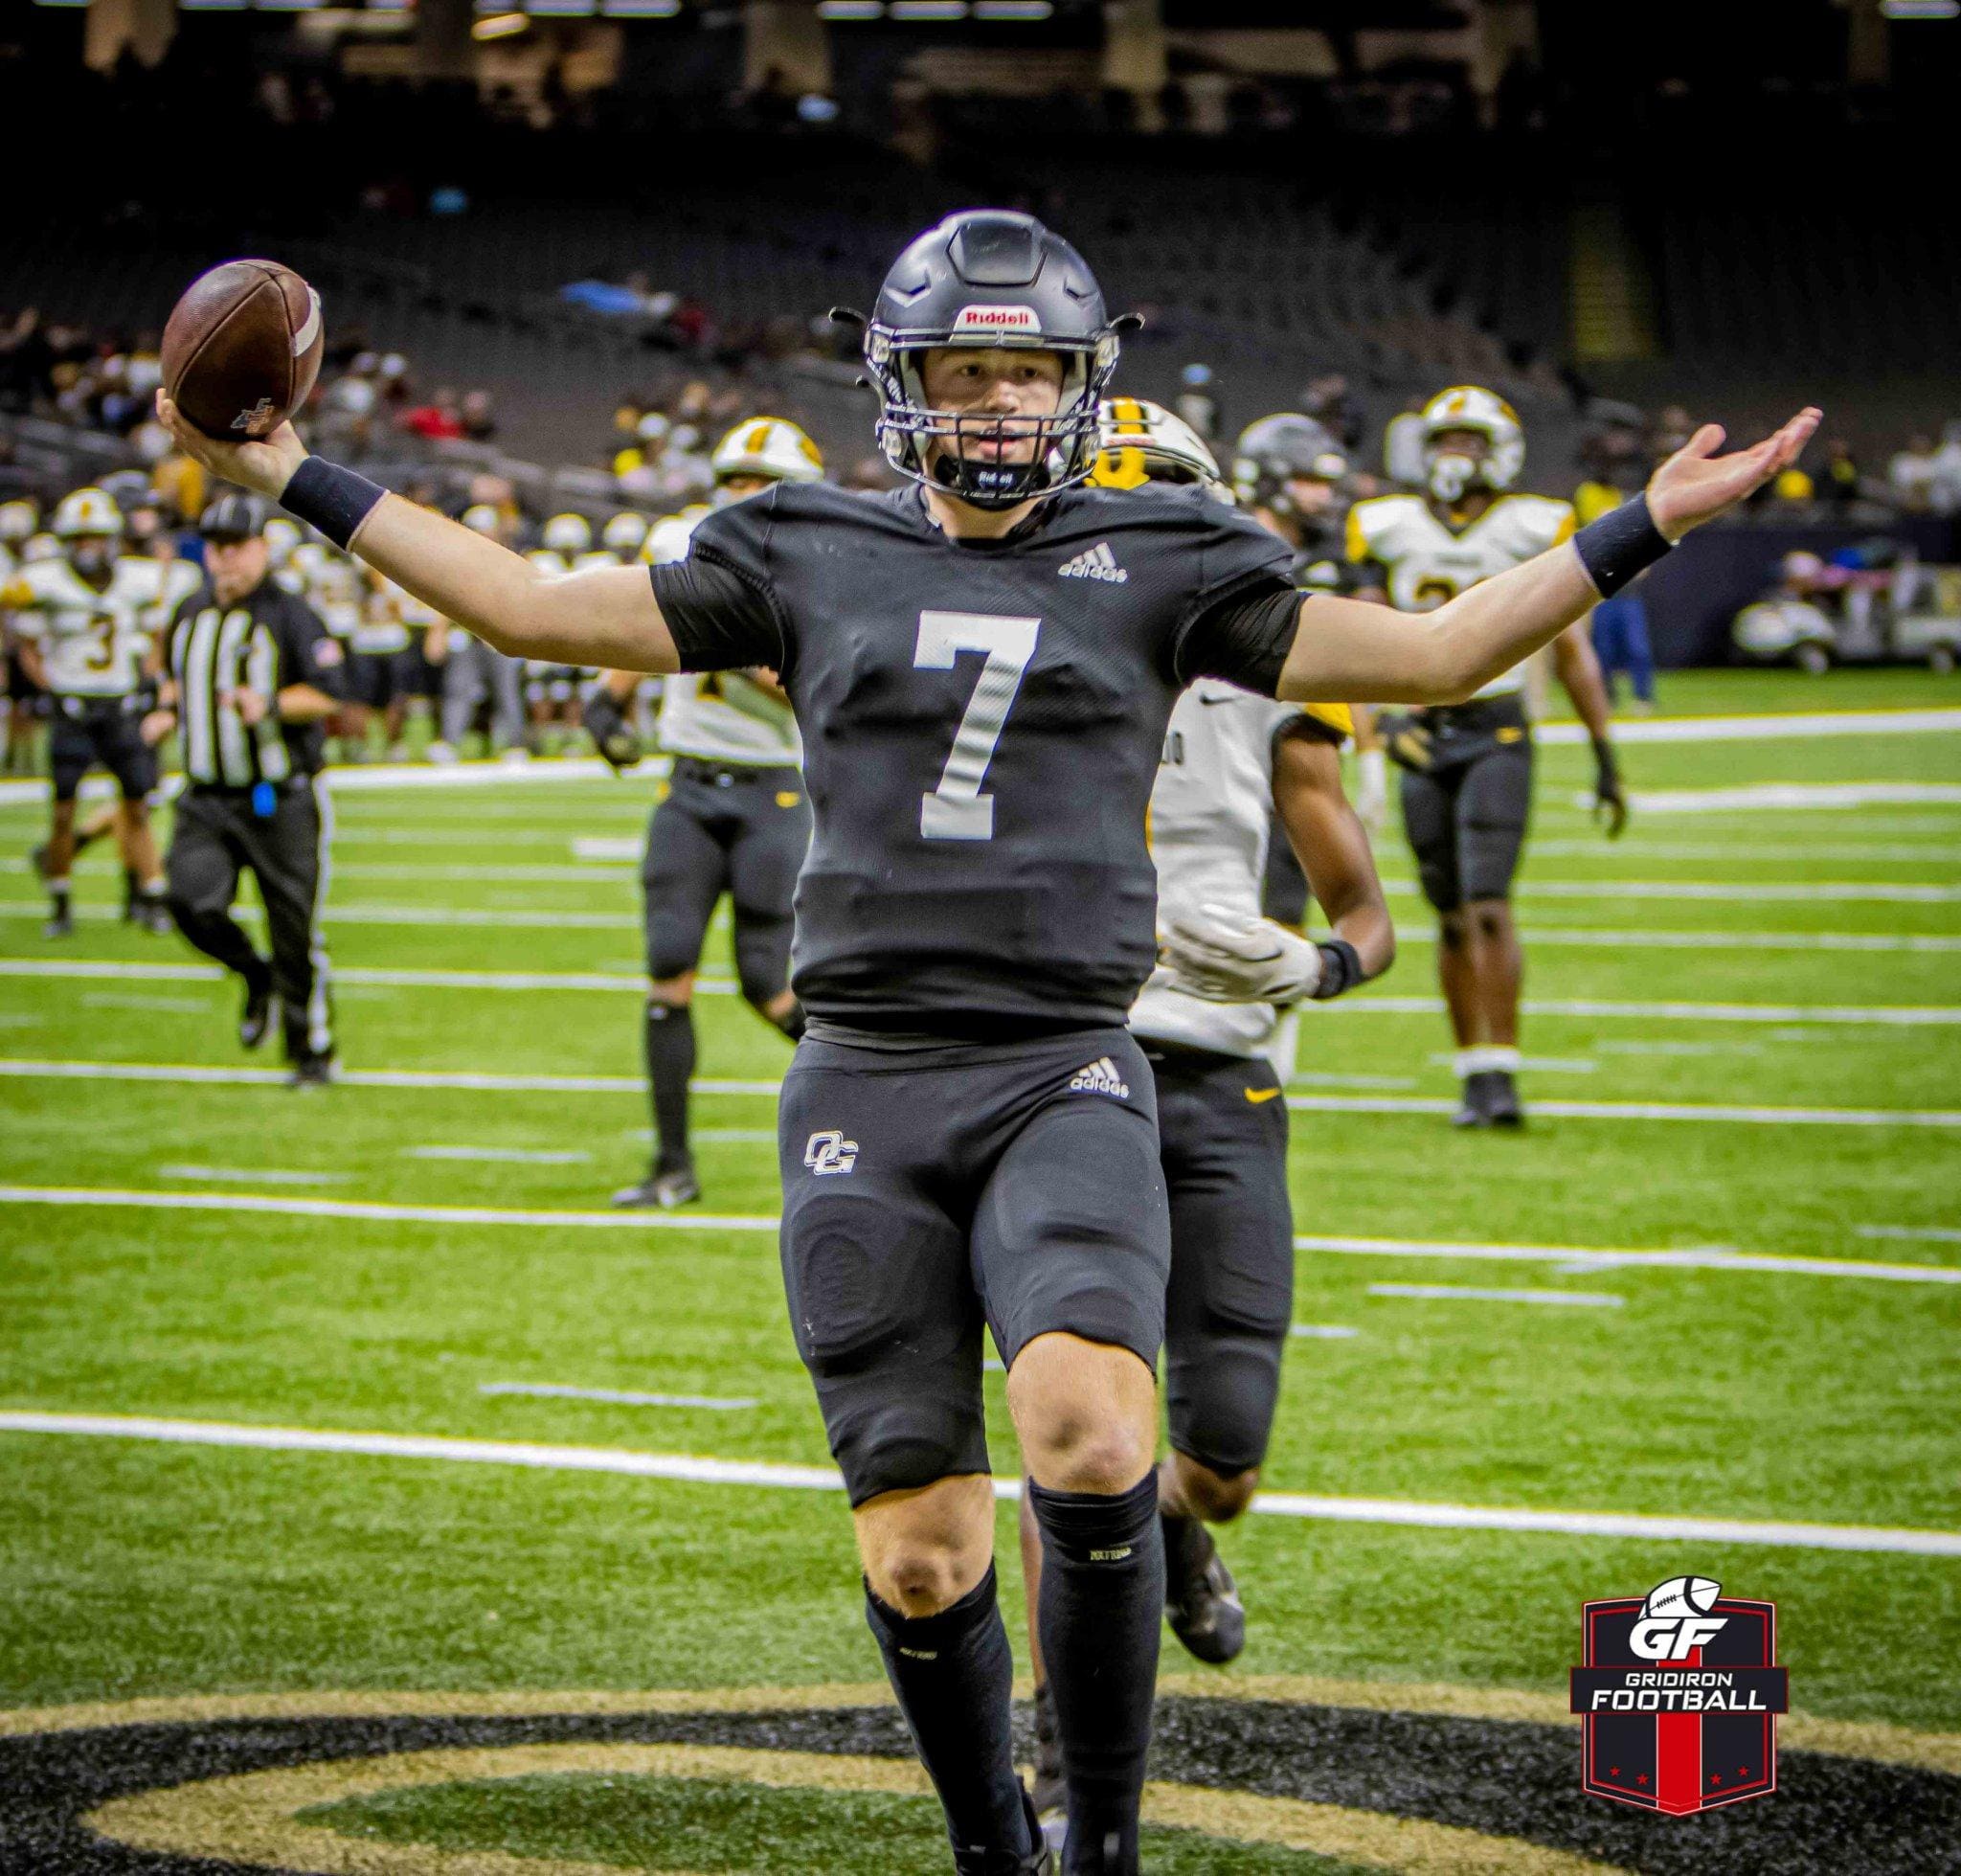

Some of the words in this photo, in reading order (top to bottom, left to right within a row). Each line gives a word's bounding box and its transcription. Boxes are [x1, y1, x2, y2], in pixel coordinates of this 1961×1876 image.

[966, 312, 1029, 324] Riddell
[1058, 562, 1128, 583] adidas
[913, 609, 1042, 841] 7
[1071, 1075, 1130, 1098] adidas
